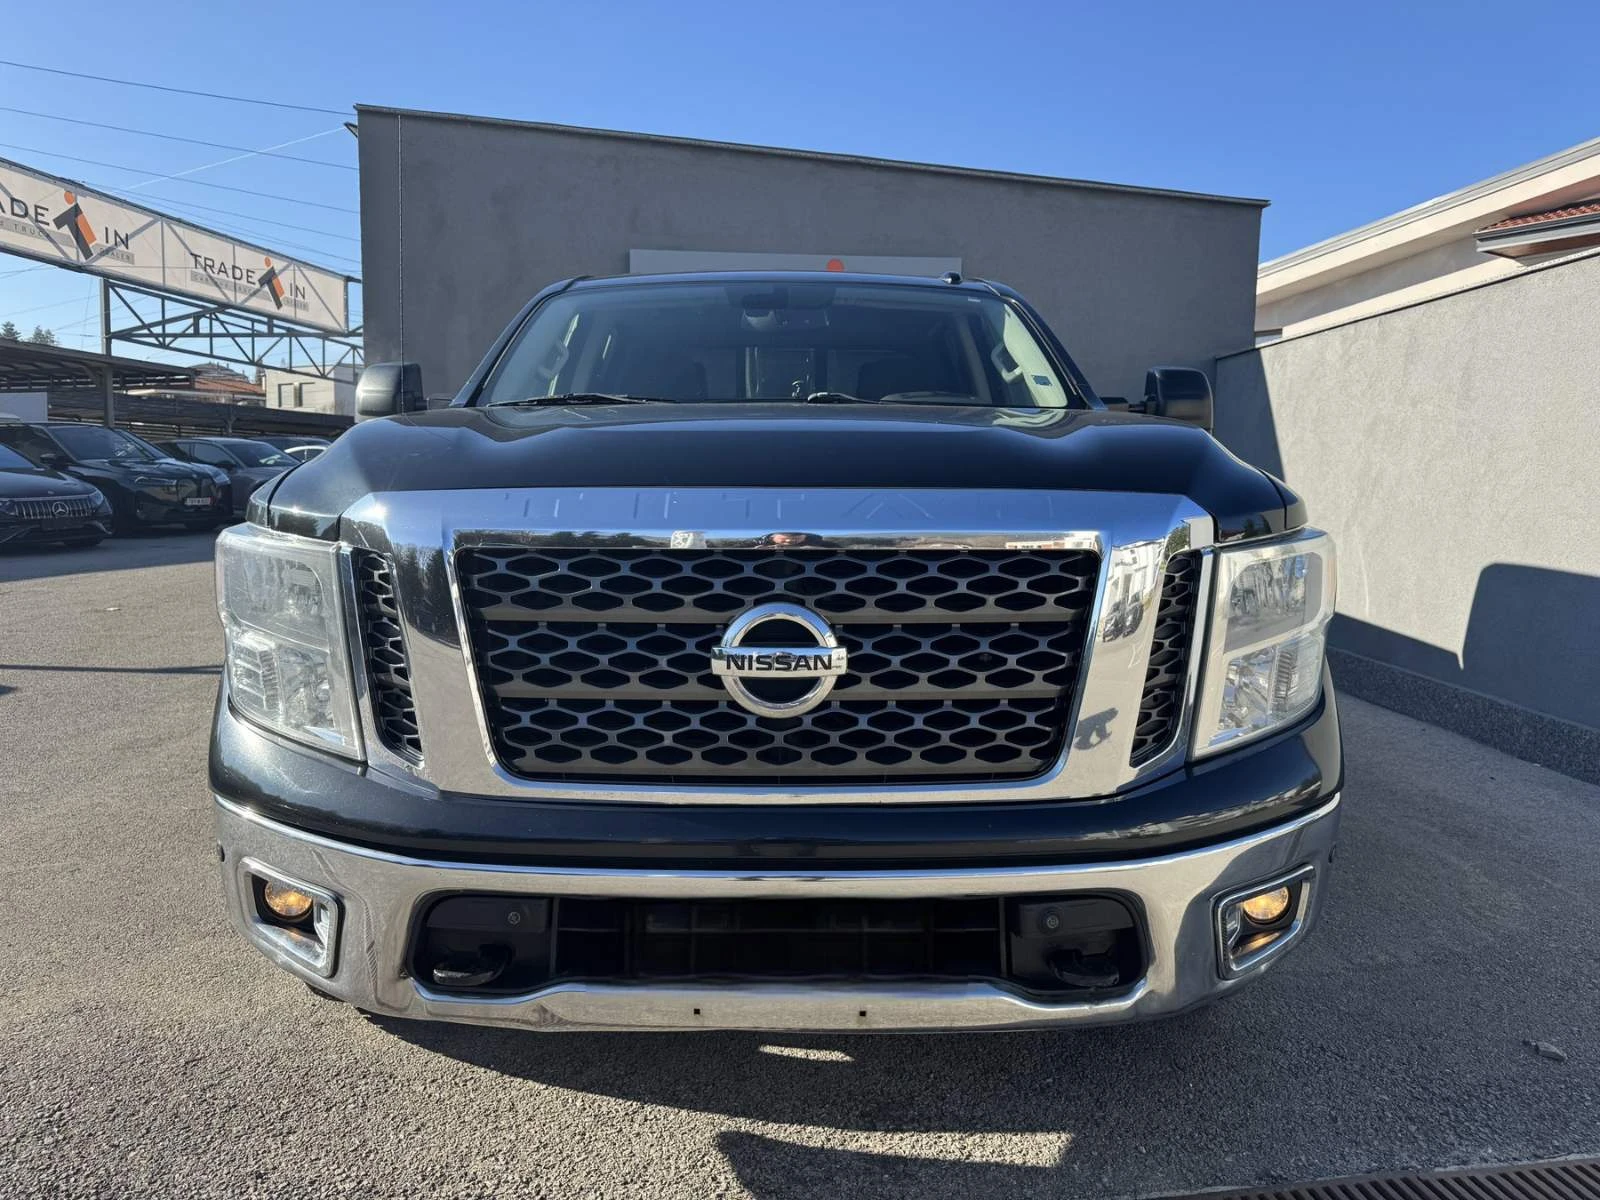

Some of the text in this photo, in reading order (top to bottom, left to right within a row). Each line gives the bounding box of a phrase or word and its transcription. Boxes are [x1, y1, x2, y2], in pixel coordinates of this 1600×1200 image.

[104, 226, 129, 250] IN
[190, 252, 256, 286] TRADE
[289, 282, 306, 300] IN
[726, 654, 832, 671] NISSAN
